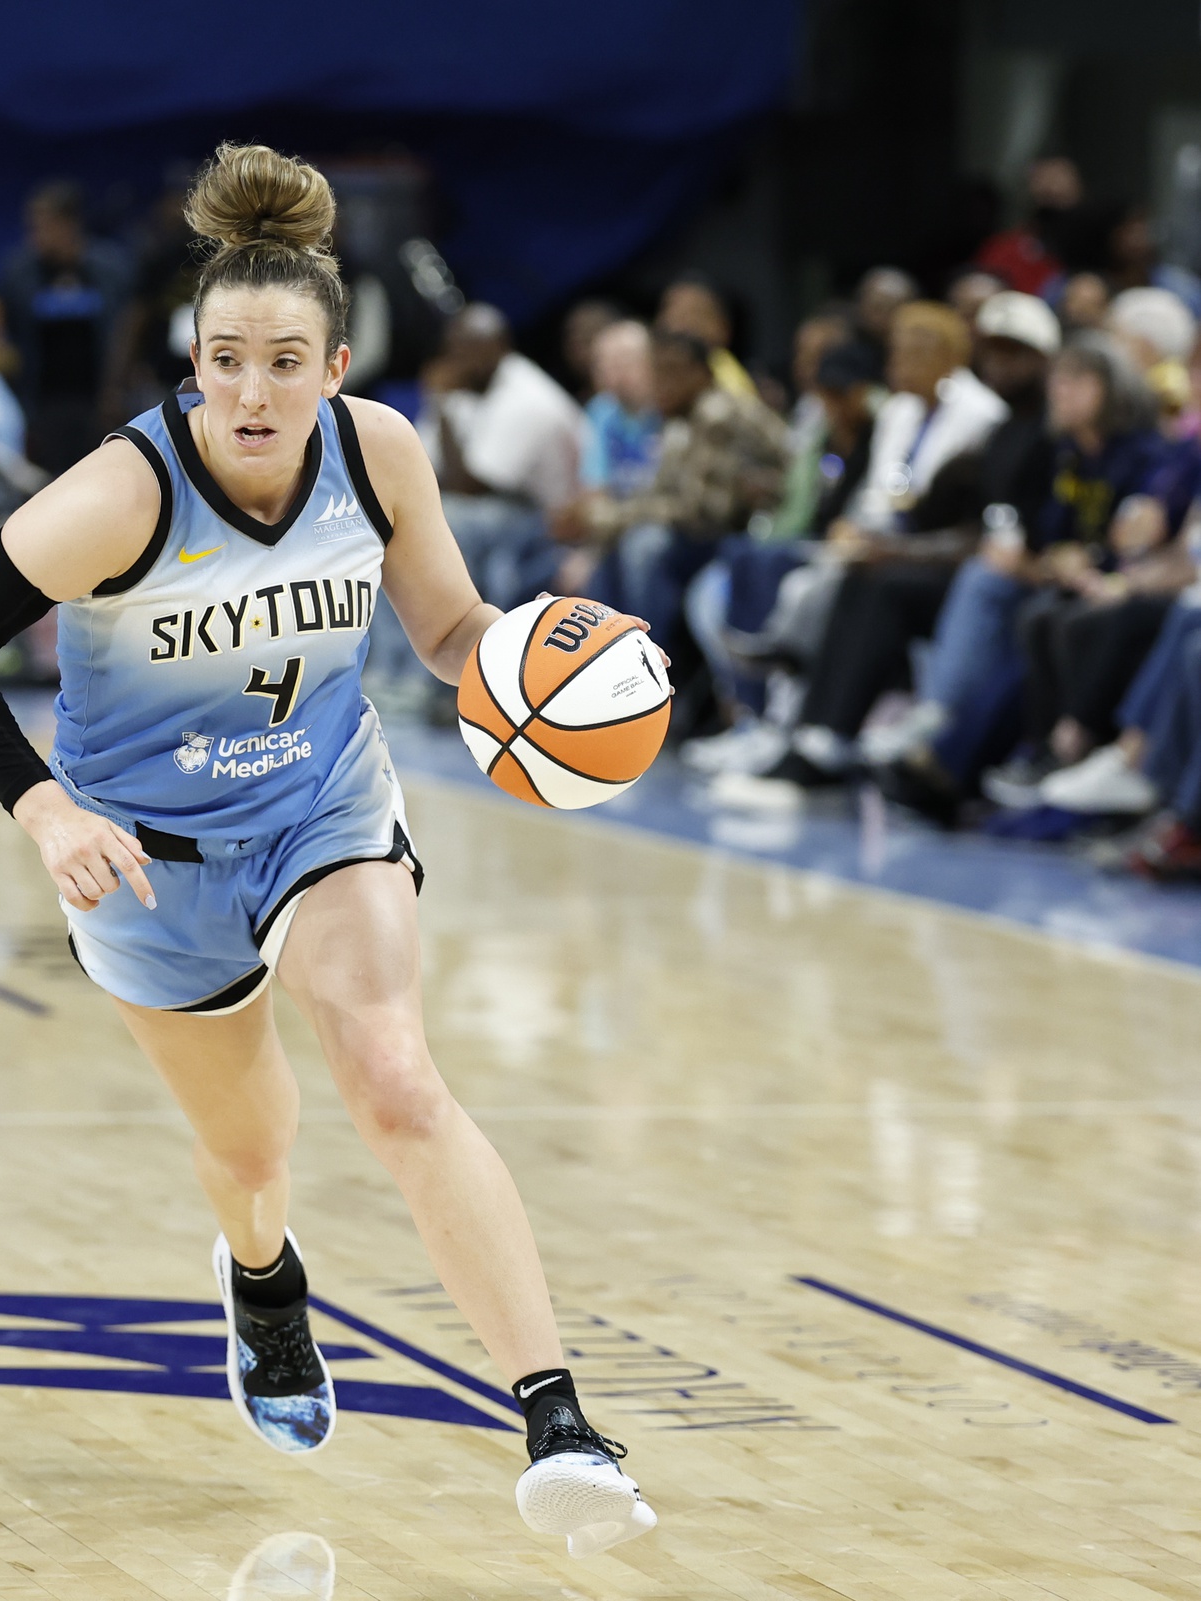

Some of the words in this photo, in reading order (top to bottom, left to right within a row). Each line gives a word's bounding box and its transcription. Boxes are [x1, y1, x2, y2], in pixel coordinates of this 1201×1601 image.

[313, 518, 363, 535] MAGELLAN
[242, 656, 305, 728] 4
[629, 678, 645, 692] BALL
